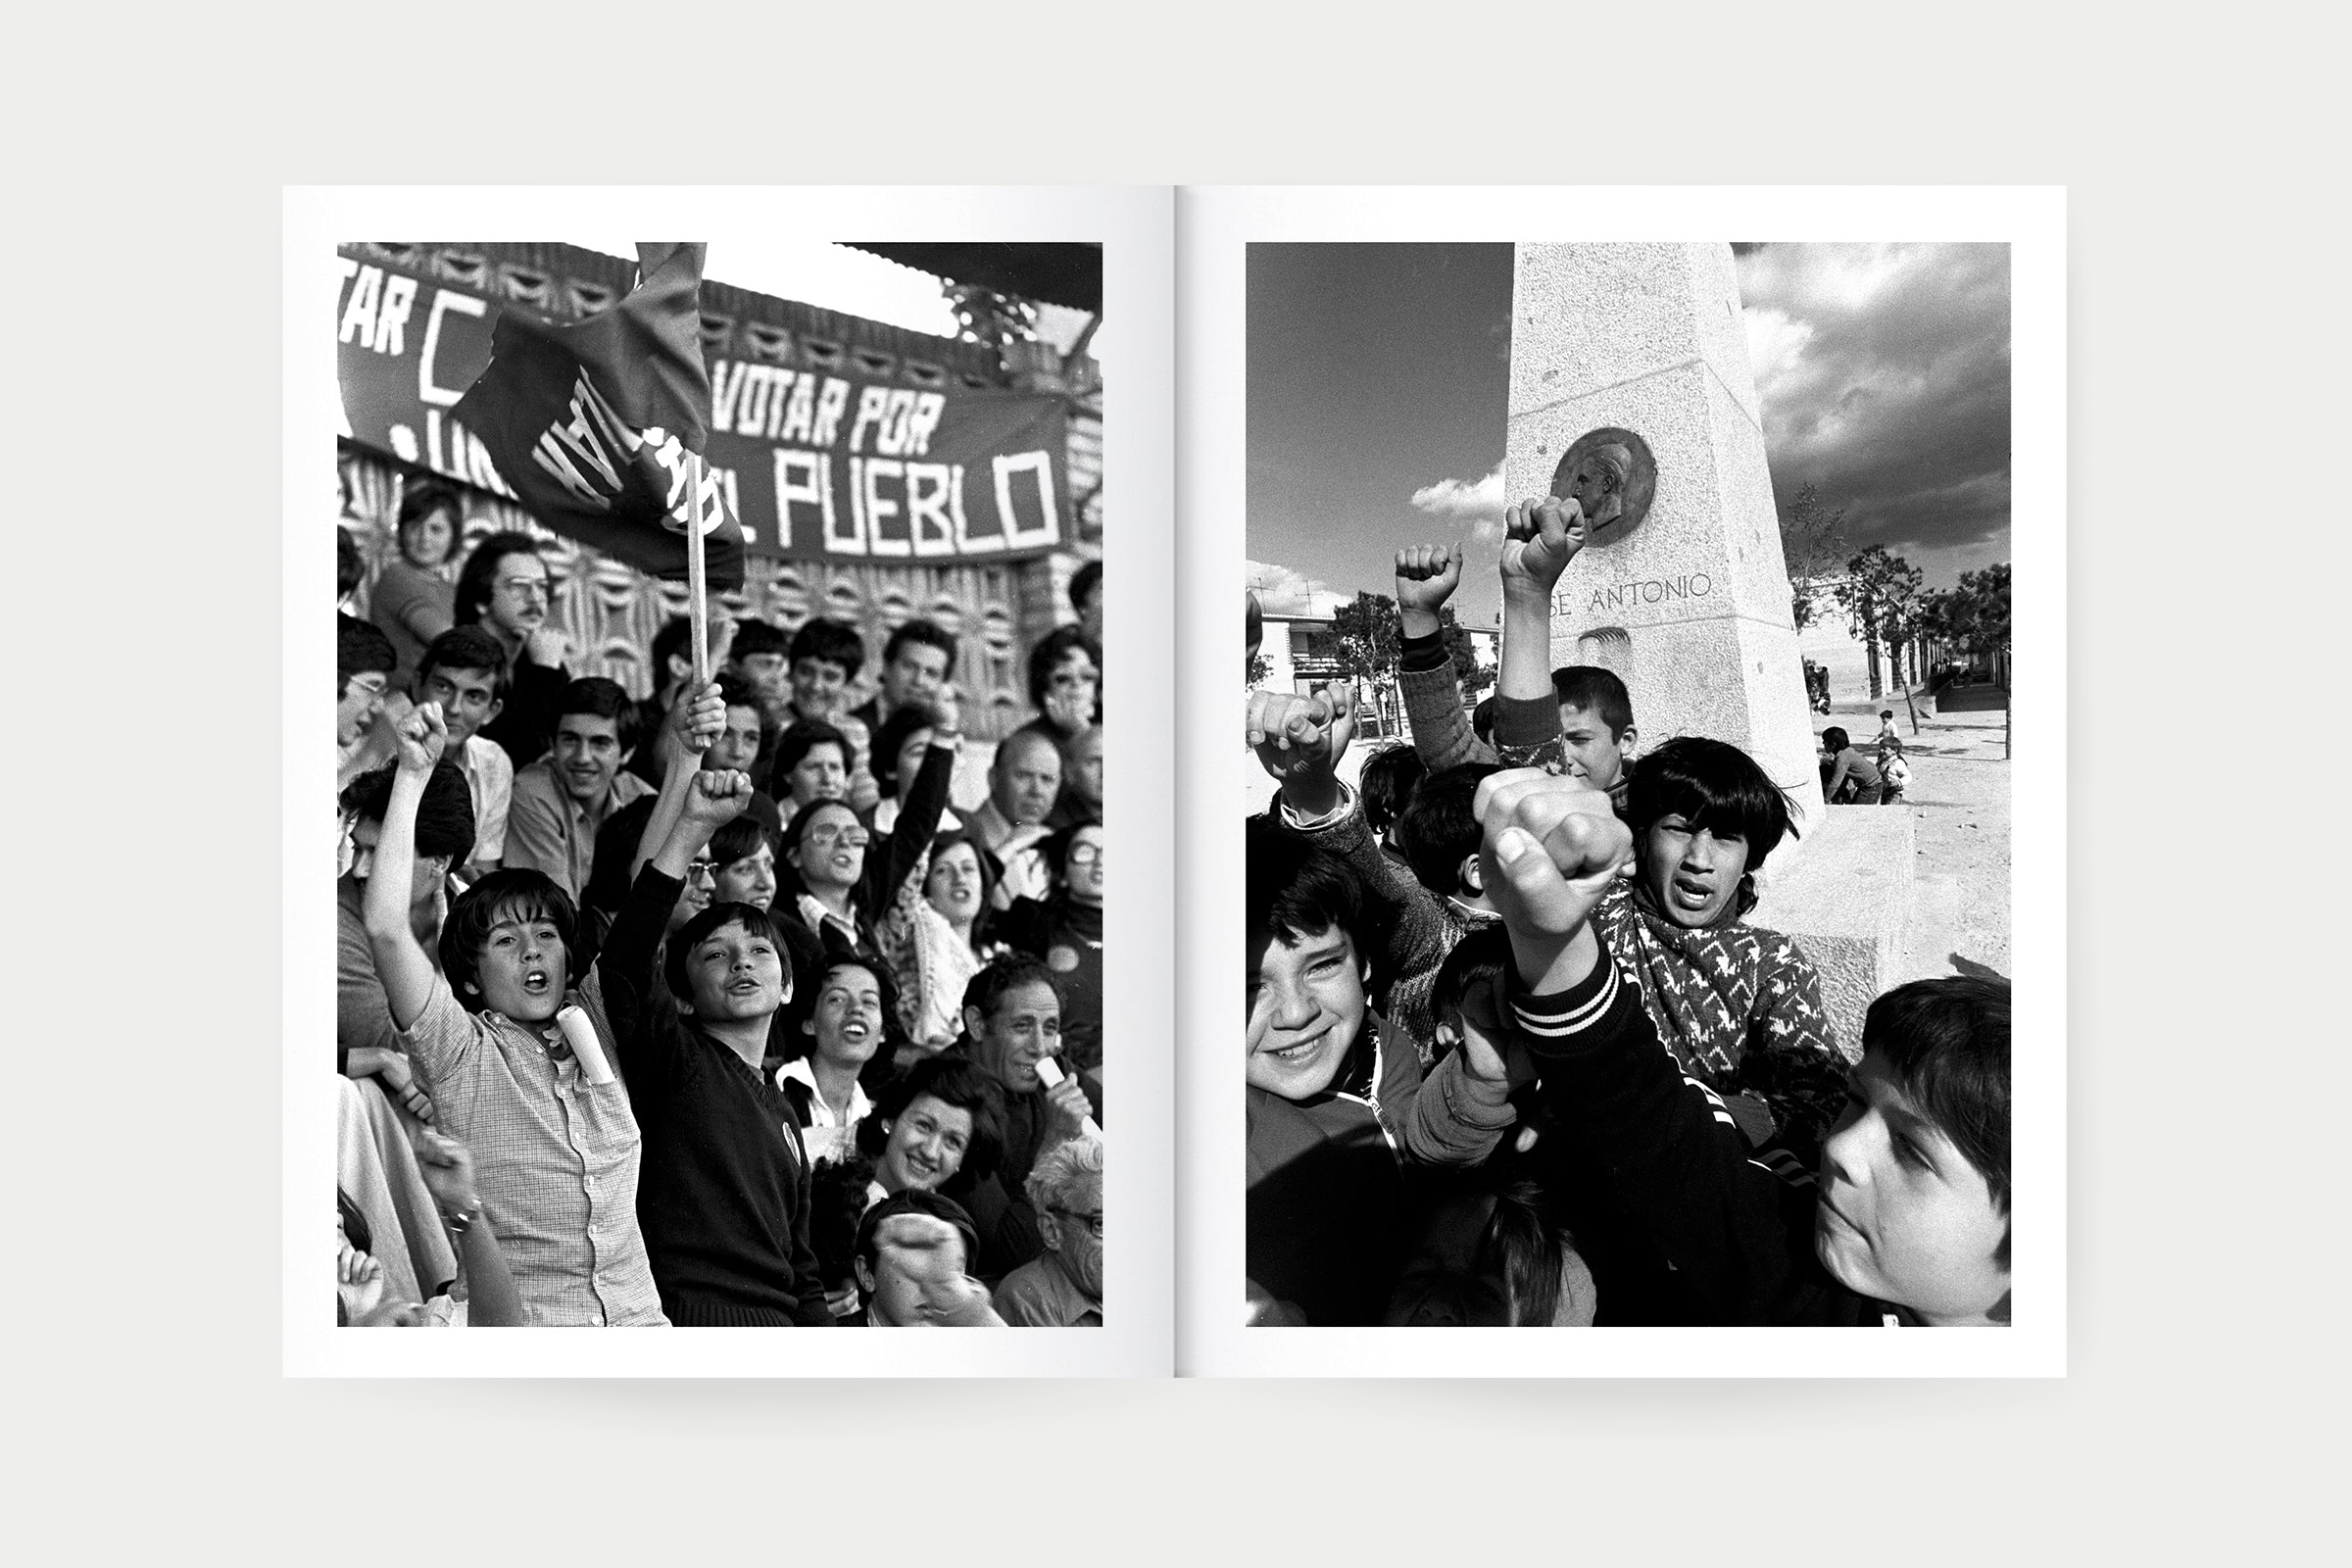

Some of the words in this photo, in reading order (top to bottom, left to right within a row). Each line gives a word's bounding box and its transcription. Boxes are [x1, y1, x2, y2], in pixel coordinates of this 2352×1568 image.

[711, 359, 851, 447] VOTAR
[849, 384, 947, 456] POR
[773, 448, 1060, 557] PUEBLO
[1588, 572, 1712, 612] ANTONIO
